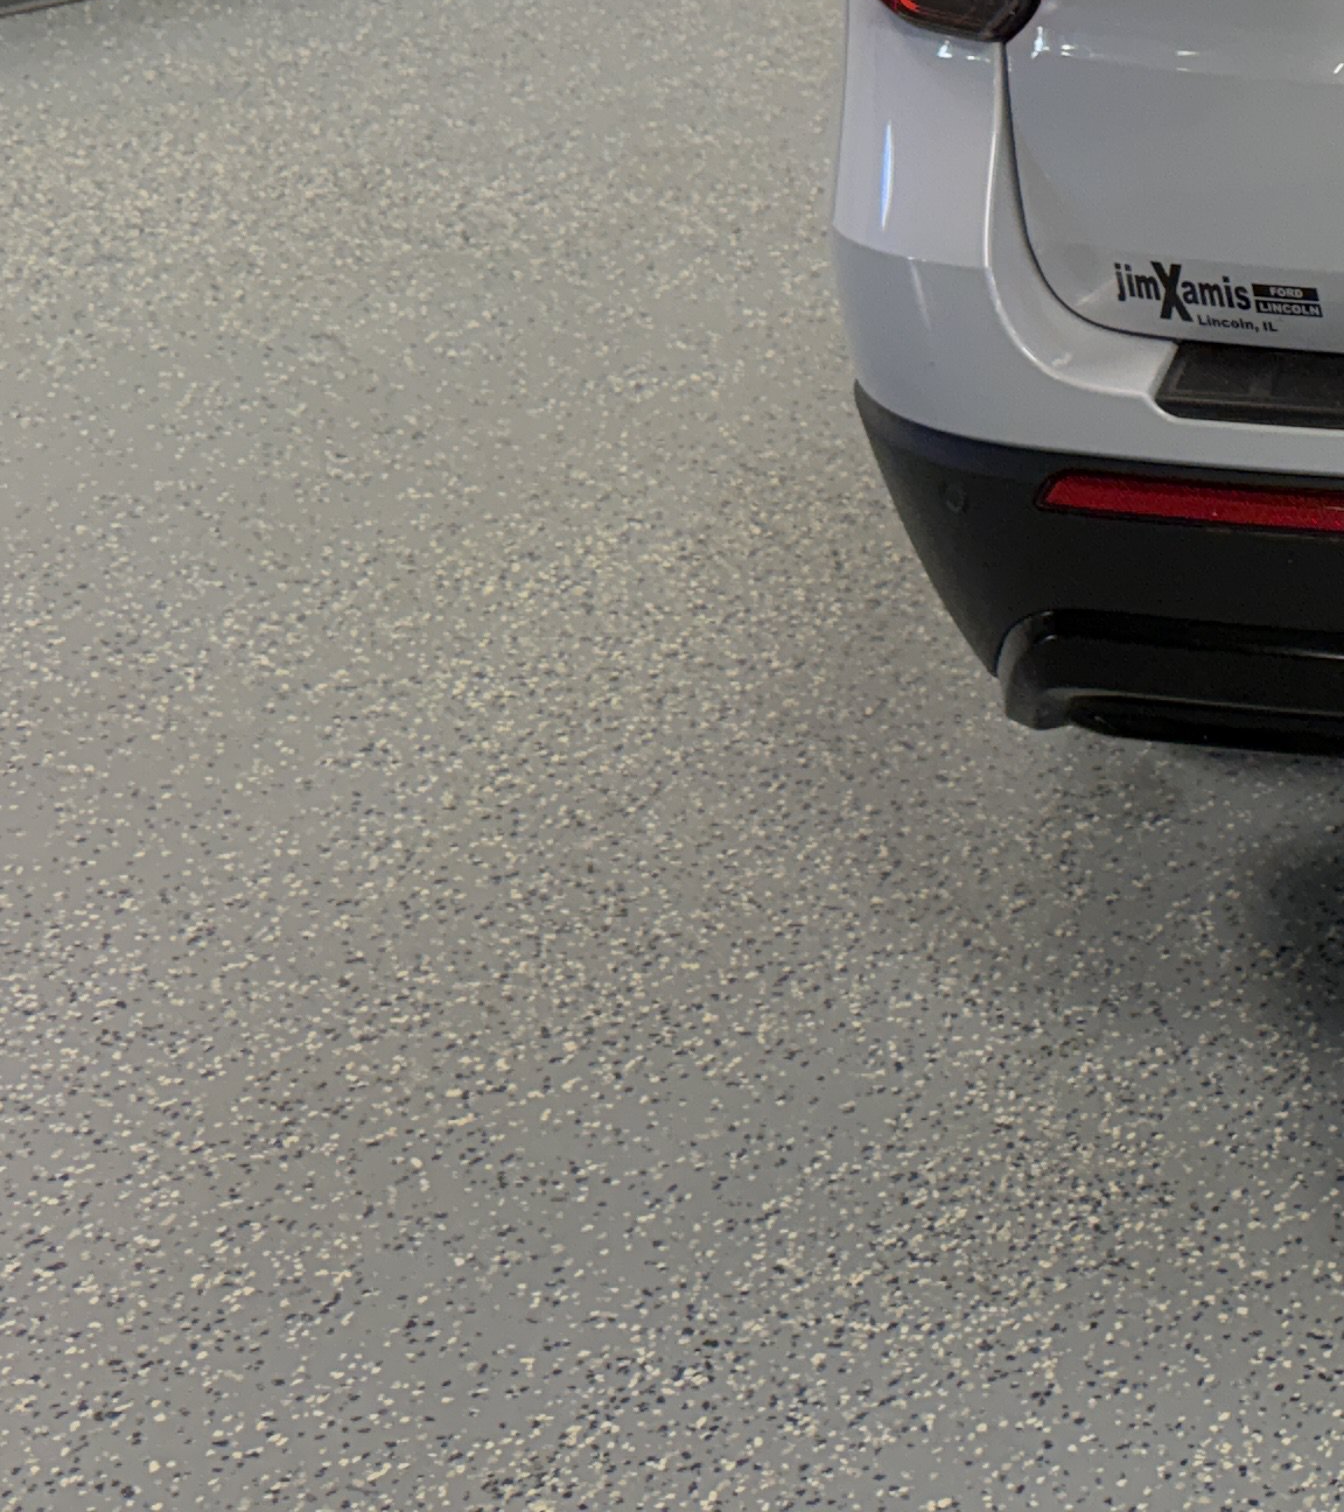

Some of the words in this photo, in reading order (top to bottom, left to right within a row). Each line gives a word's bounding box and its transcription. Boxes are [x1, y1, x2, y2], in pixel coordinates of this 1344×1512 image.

[1270, 288, 1303, 298] FORD
[1259, 301, 1320, 315] LINCOLN
[1197, 315, 1259, 332] Lincoln,
[1263, 322, 1278, 332] IL
